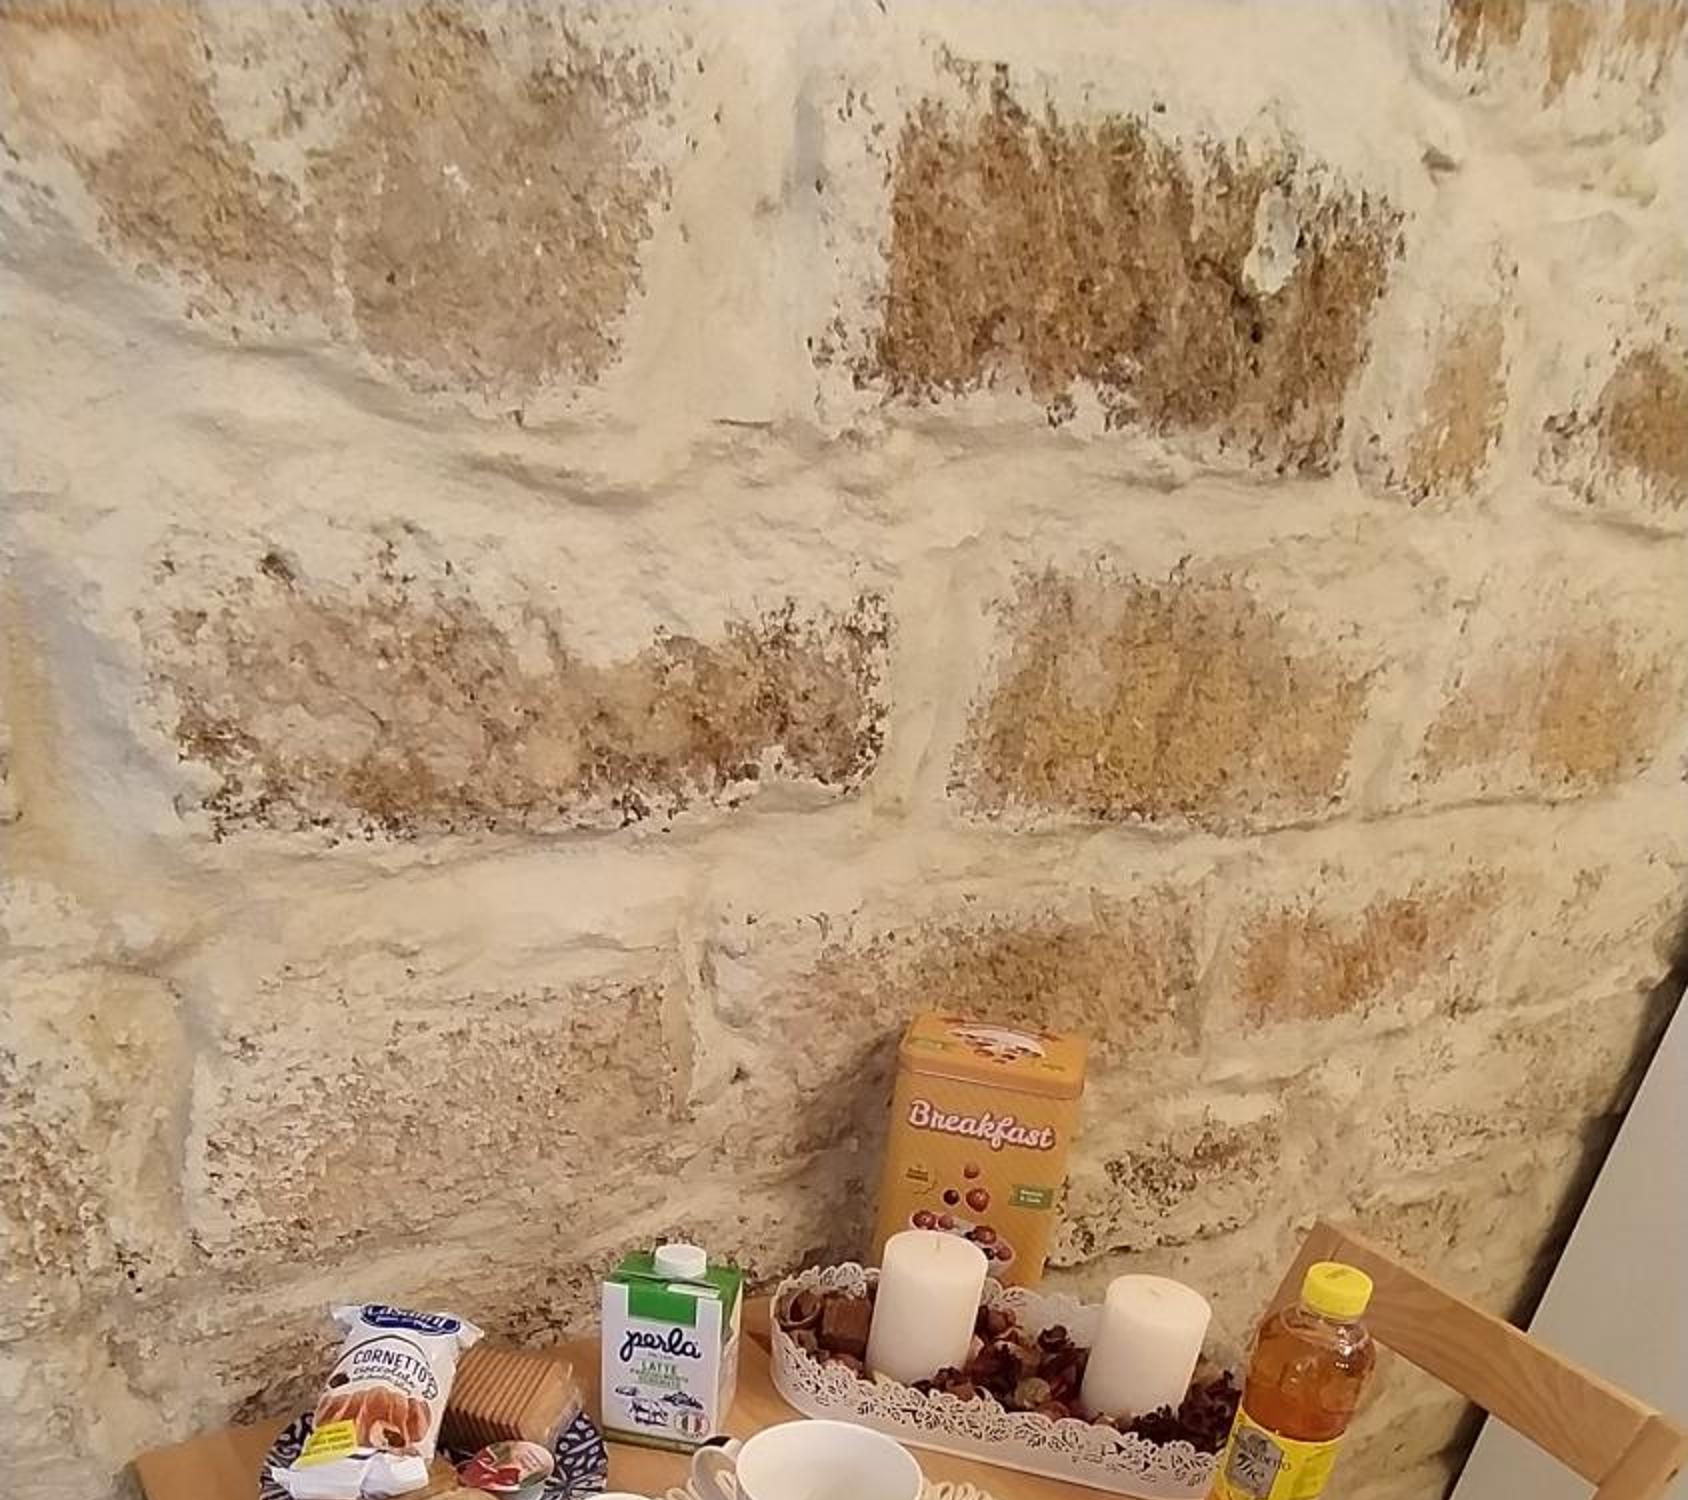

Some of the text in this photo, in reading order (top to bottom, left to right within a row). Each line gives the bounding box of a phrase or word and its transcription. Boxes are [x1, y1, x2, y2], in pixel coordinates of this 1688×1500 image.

[908, 1099, 1055, 1150] Breakfast
[620, 1328, 701, 1361] perla
[353, 1349, 427, 1383] CORNETTO
[641, 1361, 677, 1375] LATTE
